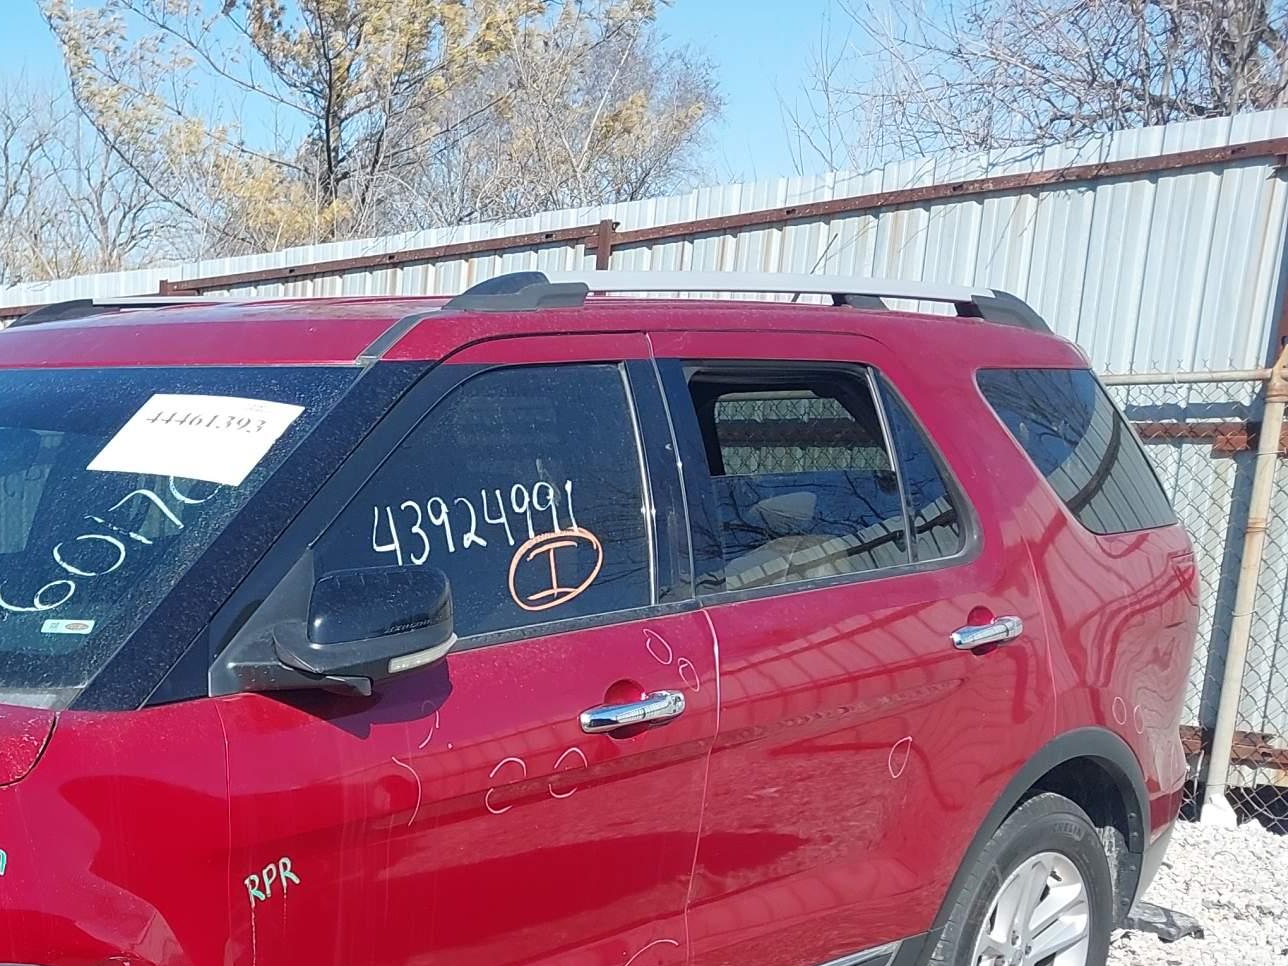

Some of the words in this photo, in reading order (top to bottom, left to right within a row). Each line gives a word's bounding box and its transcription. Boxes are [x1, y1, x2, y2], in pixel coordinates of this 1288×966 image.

[145, 410, 267, 434] 44461393
[372, 480, 580, 566] 43924991
[243, 856, 300, 908] RPR
